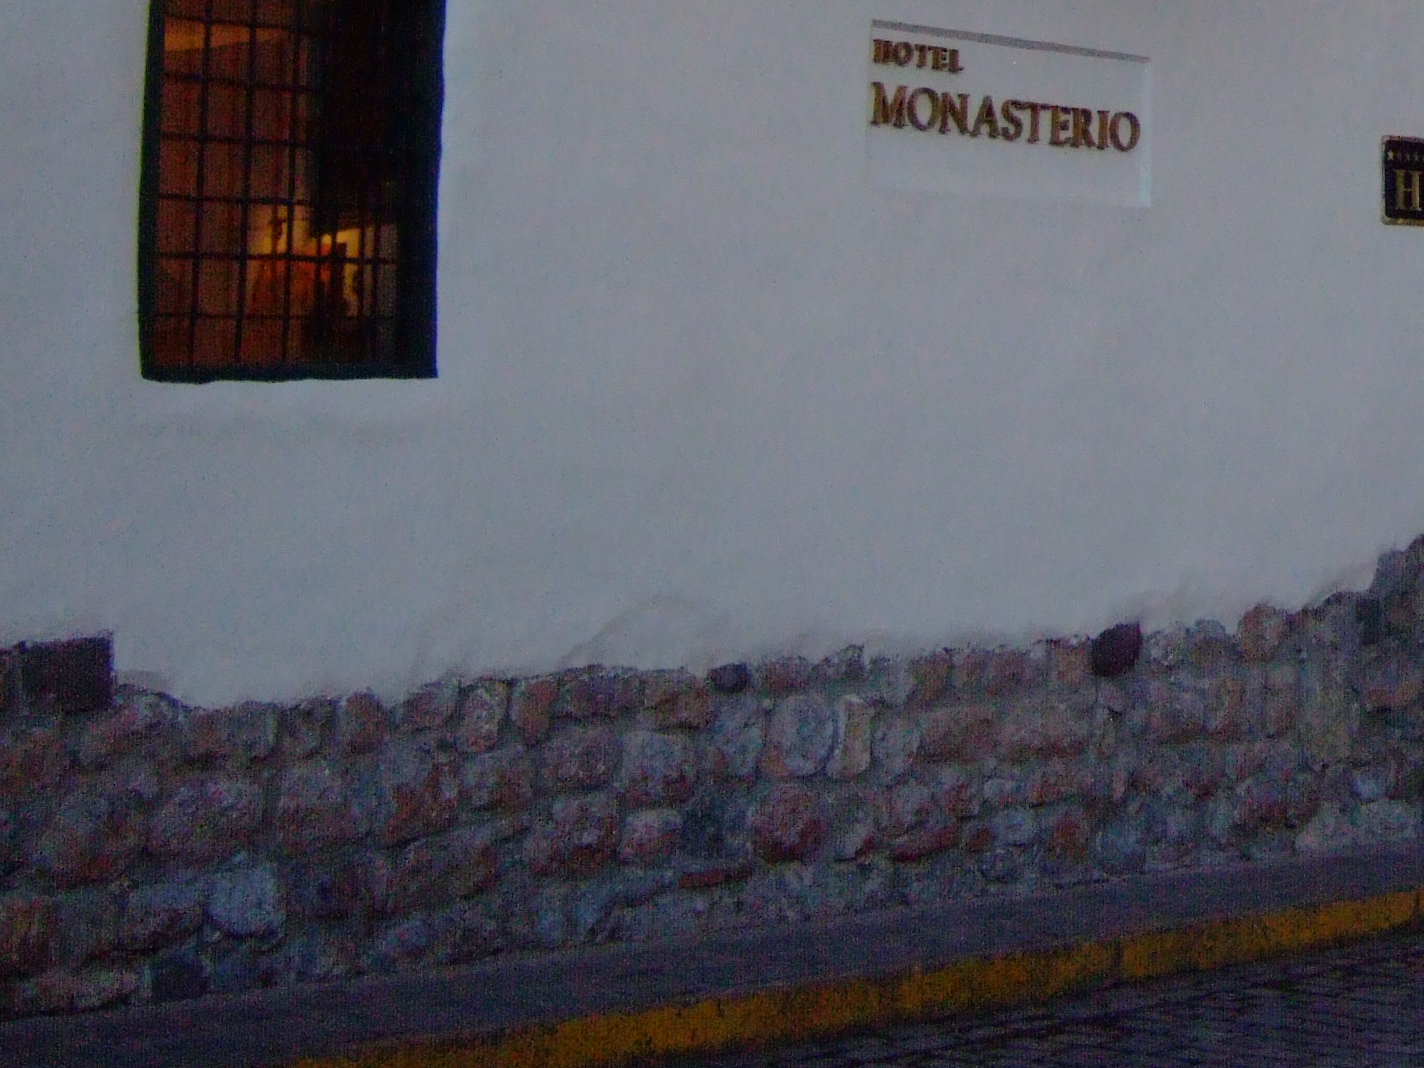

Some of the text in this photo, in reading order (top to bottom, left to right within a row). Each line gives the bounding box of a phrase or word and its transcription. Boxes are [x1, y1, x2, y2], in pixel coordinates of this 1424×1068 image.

[873, 38, 964, 73] HOTEL
[870, 82, 1141, 151] MONASTERIO
[1394, 169, 1423, 211] H
